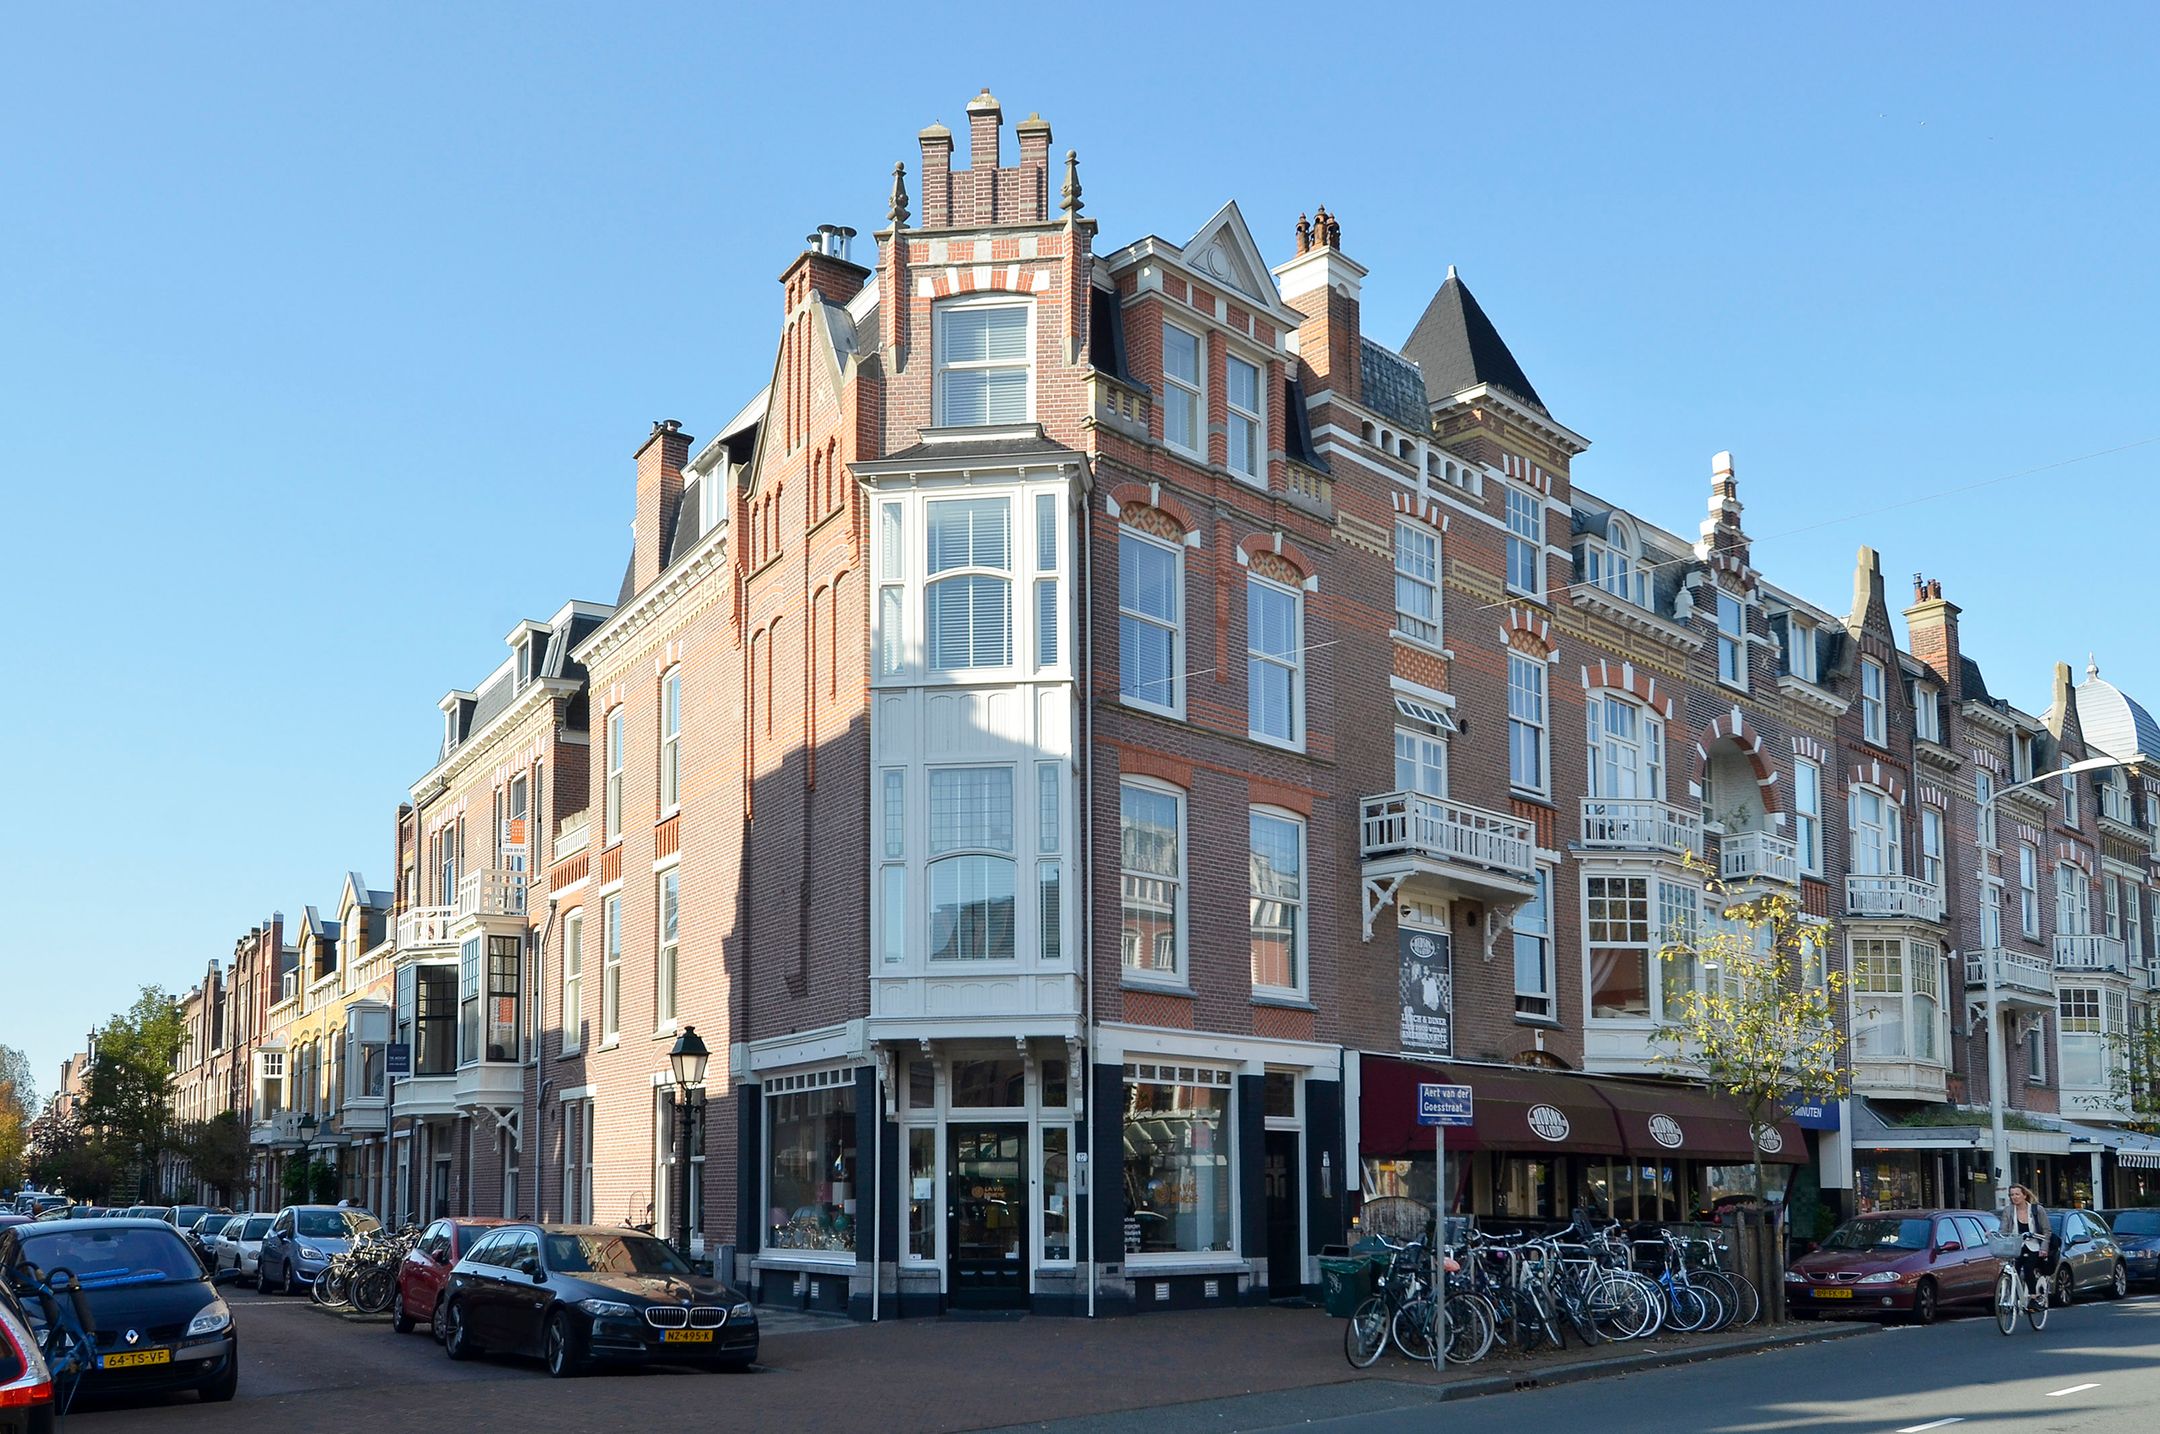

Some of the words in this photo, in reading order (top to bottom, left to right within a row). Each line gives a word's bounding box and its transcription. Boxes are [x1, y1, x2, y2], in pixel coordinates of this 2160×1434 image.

[1401, 1013, 1421, 1023] LCH
[1424, 1088, 1440, 1097] Aert
[1443, 1090, 1455, 1098] van
[1457, 1089, 1469, 1099] der
[1424, 1102, 1463, 1112] Goesstraat
[668, 1331, 710, 1340] NZ-495-K
[109, 1351, 165, 1366] 64-TS-VF
